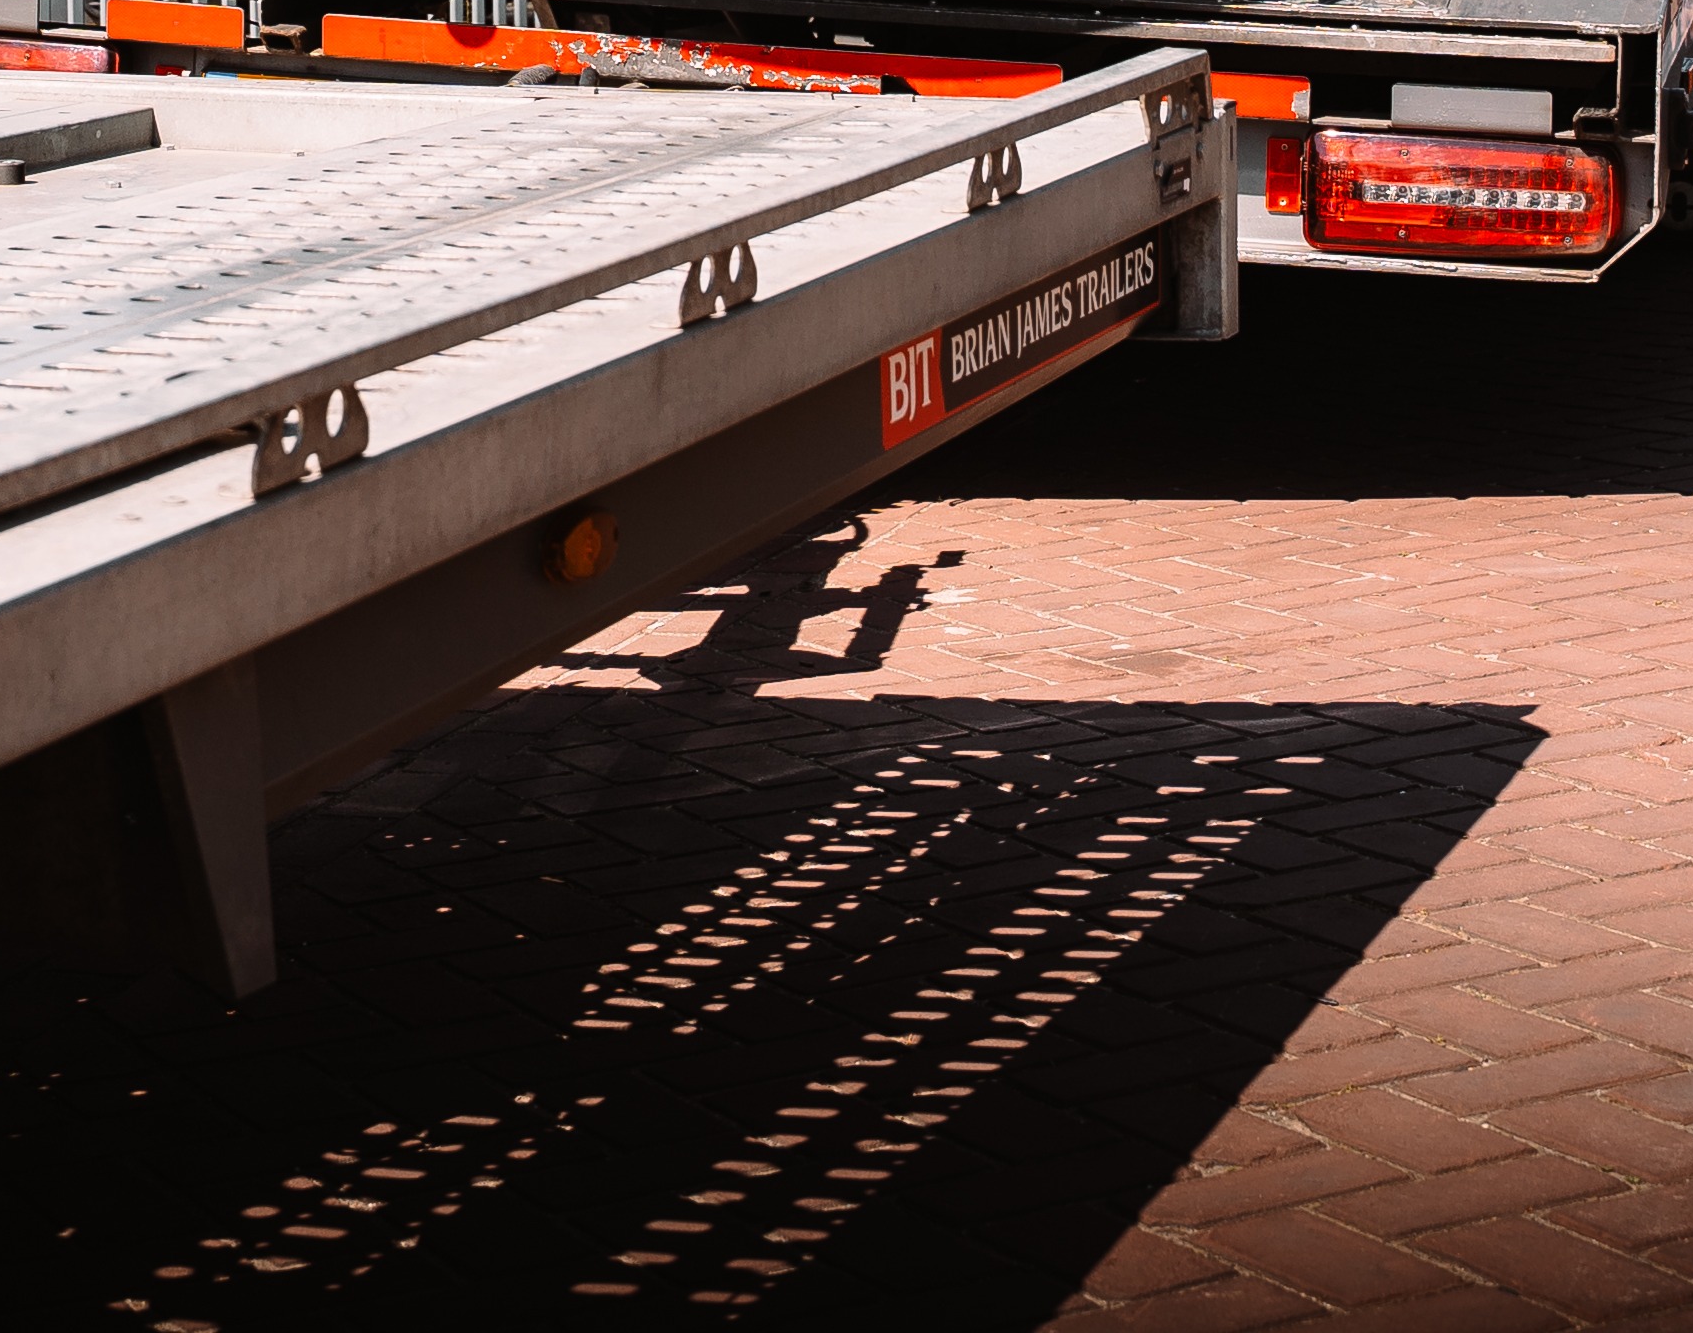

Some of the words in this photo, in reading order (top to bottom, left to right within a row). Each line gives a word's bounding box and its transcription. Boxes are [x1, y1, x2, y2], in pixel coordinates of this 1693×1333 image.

[888, 336, 935, 422] BJT
[951, 310, 1011, 383] BRIAN
[1016, 281, 1072, 359] JAMES
[1077, 241, 1154, 319] TRAILERS
